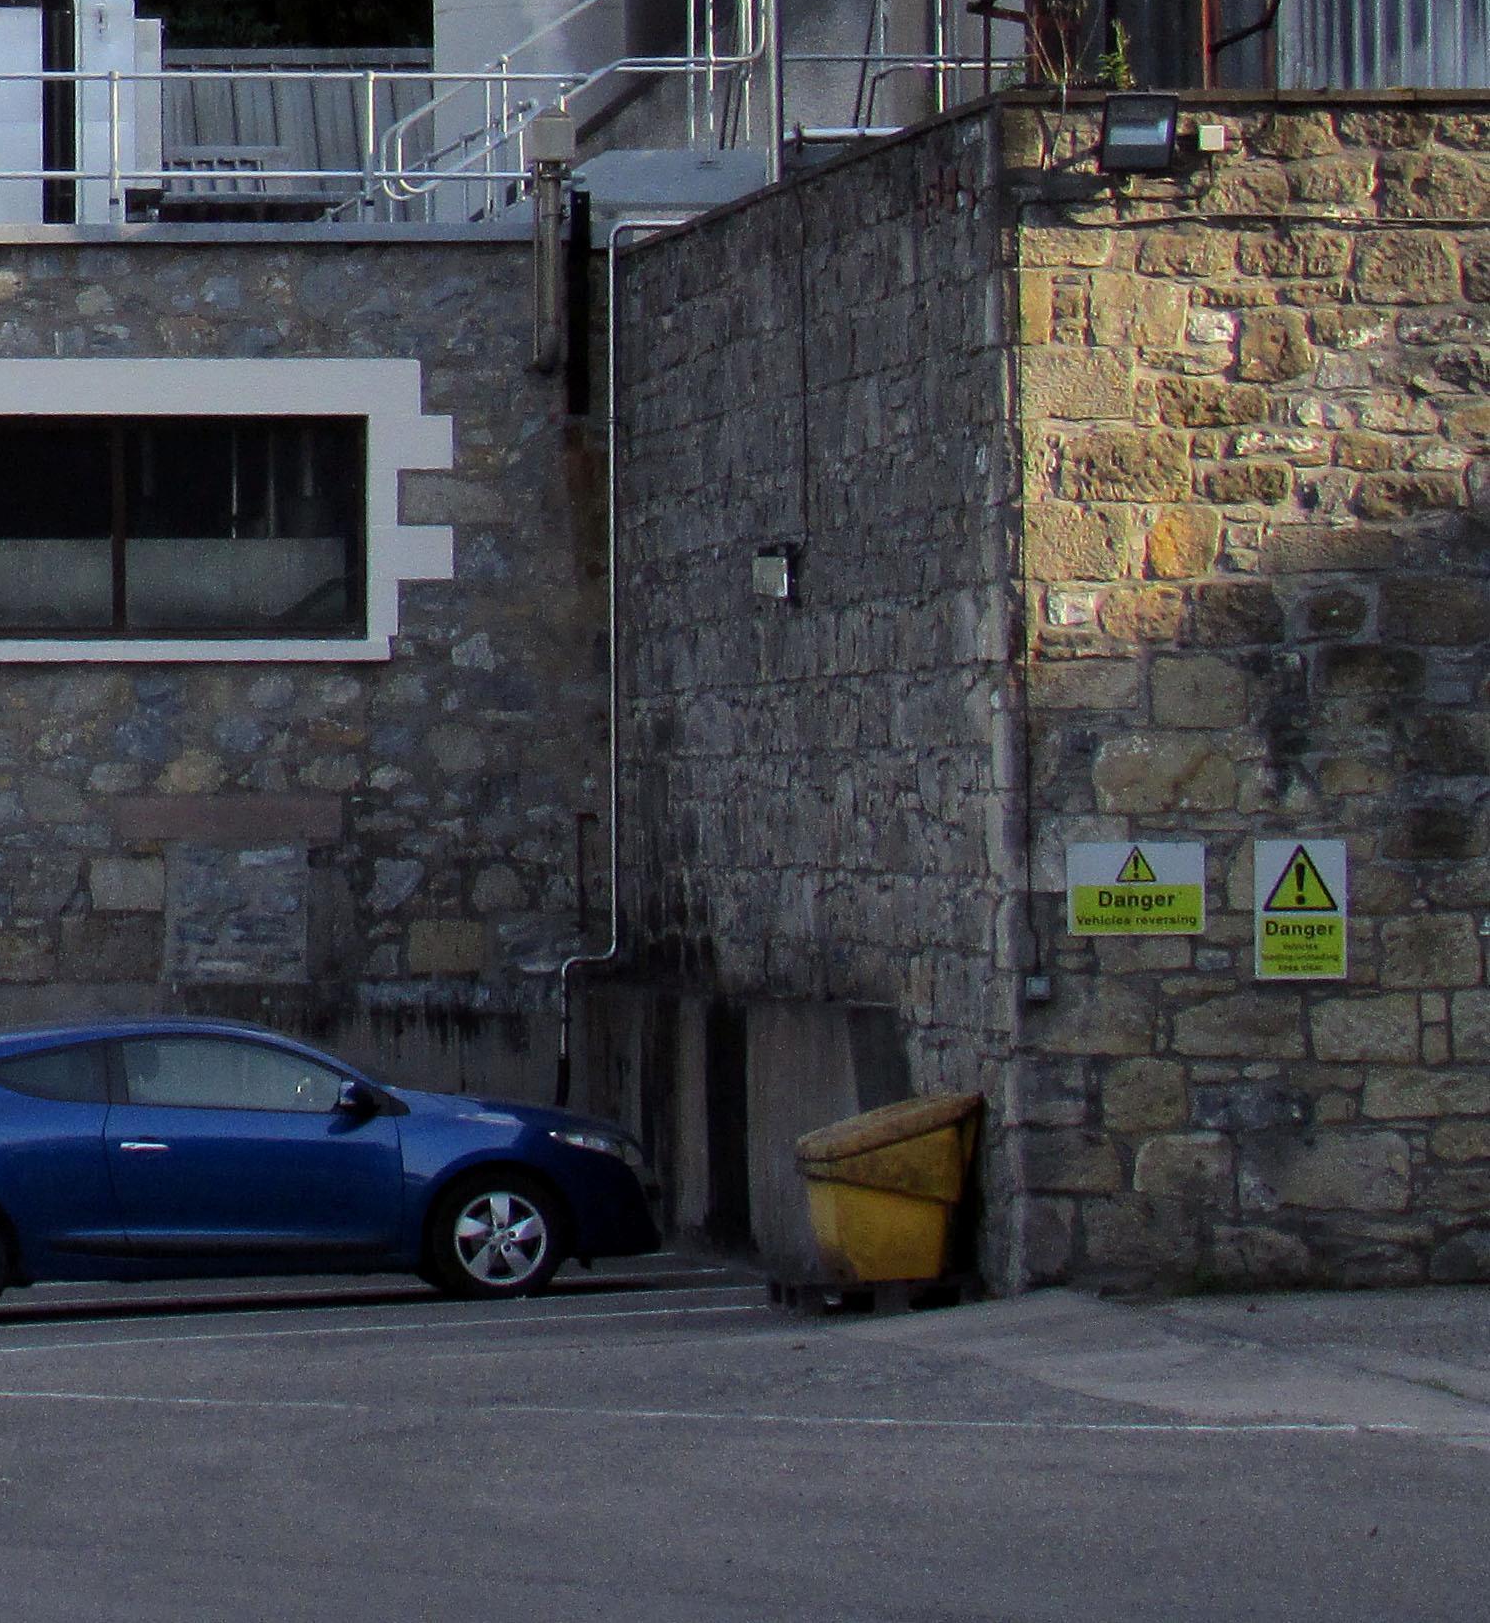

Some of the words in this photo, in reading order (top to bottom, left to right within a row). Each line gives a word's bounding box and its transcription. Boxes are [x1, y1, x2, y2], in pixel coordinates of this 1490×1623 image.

[1098, 890, 1176, 911] Danger
[1076, 914, 1131, 926] Vehicles
[1135, 914, 1197, 928] reversing
[1265, 920, 1334, 939] Danger
